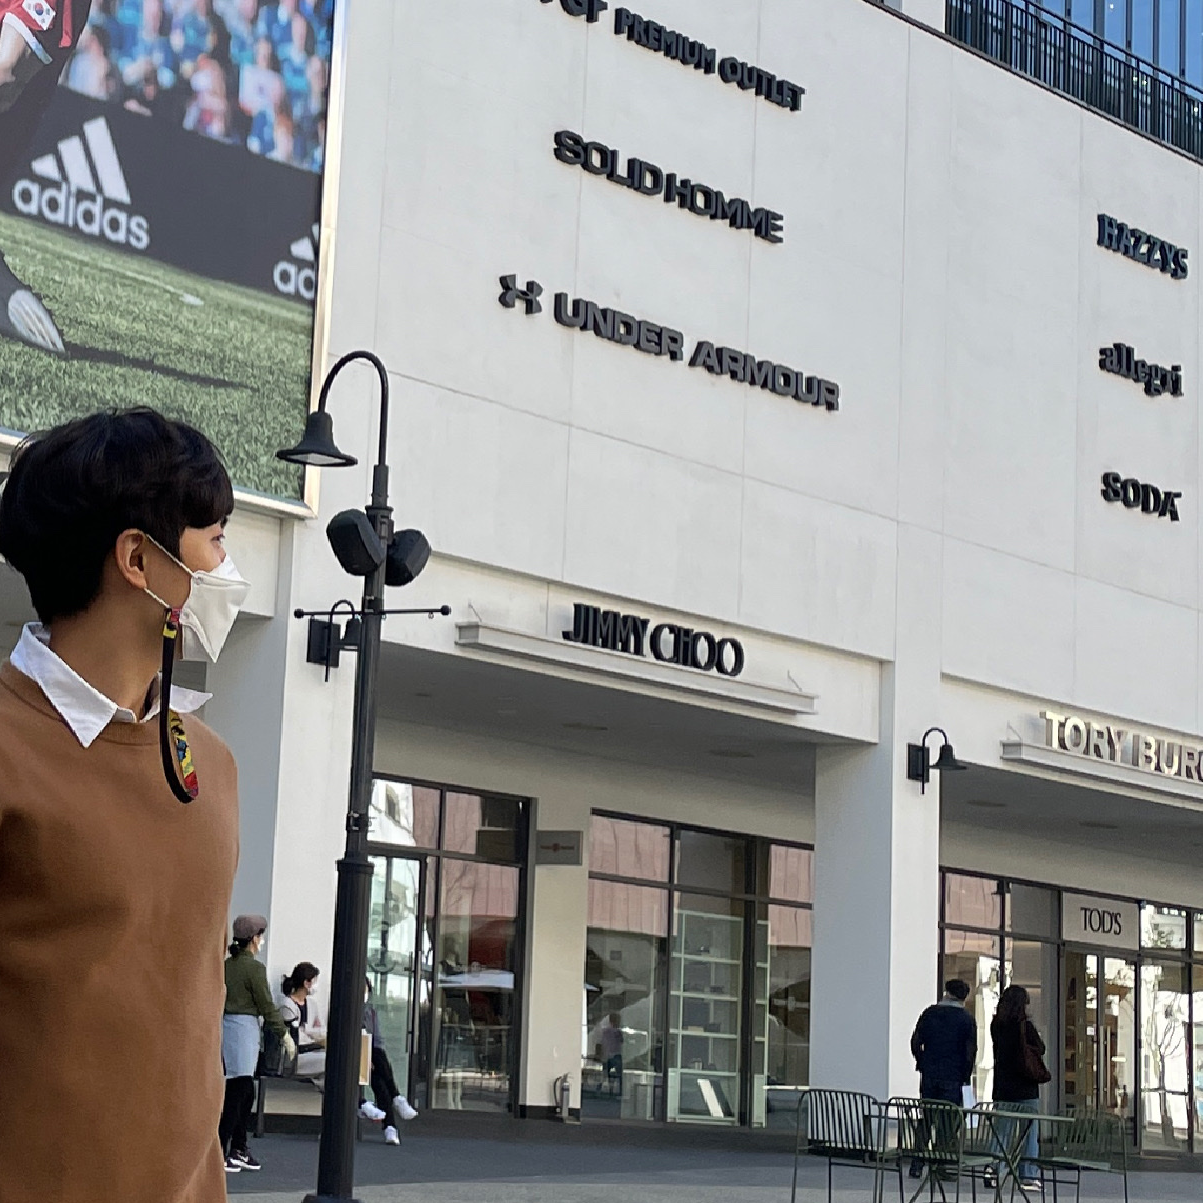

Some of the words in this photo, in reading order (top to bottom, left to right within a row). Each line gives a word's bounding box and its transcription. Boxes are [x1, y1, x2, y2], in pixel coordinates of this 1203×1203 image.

[614, 7, 717, 75] PREMIUM
[718, 56, 806, 111] OUTLET
[12, 177, 150, 250] adidas
[553, 130, 664, 196] SOLID
[664, 173, 784, 243] HOMME
[1097, 213, 1188, 280] HAZZYS
[554, 292, 684, 361] UNDER
[688, 340, 839, 411] ARMOUR
[1099, 342, 1185, 398] allegri
[1100, 471, 1183, 521] SODA
[561, 602, 650, 656] JIMMY
[649, 623, 744, 677] CHOO
[1039, 710, 1128, 763] TORY
[1131, 733, 1203, 783] BUR
[1080, 906, 1122, 936] TOD'S
